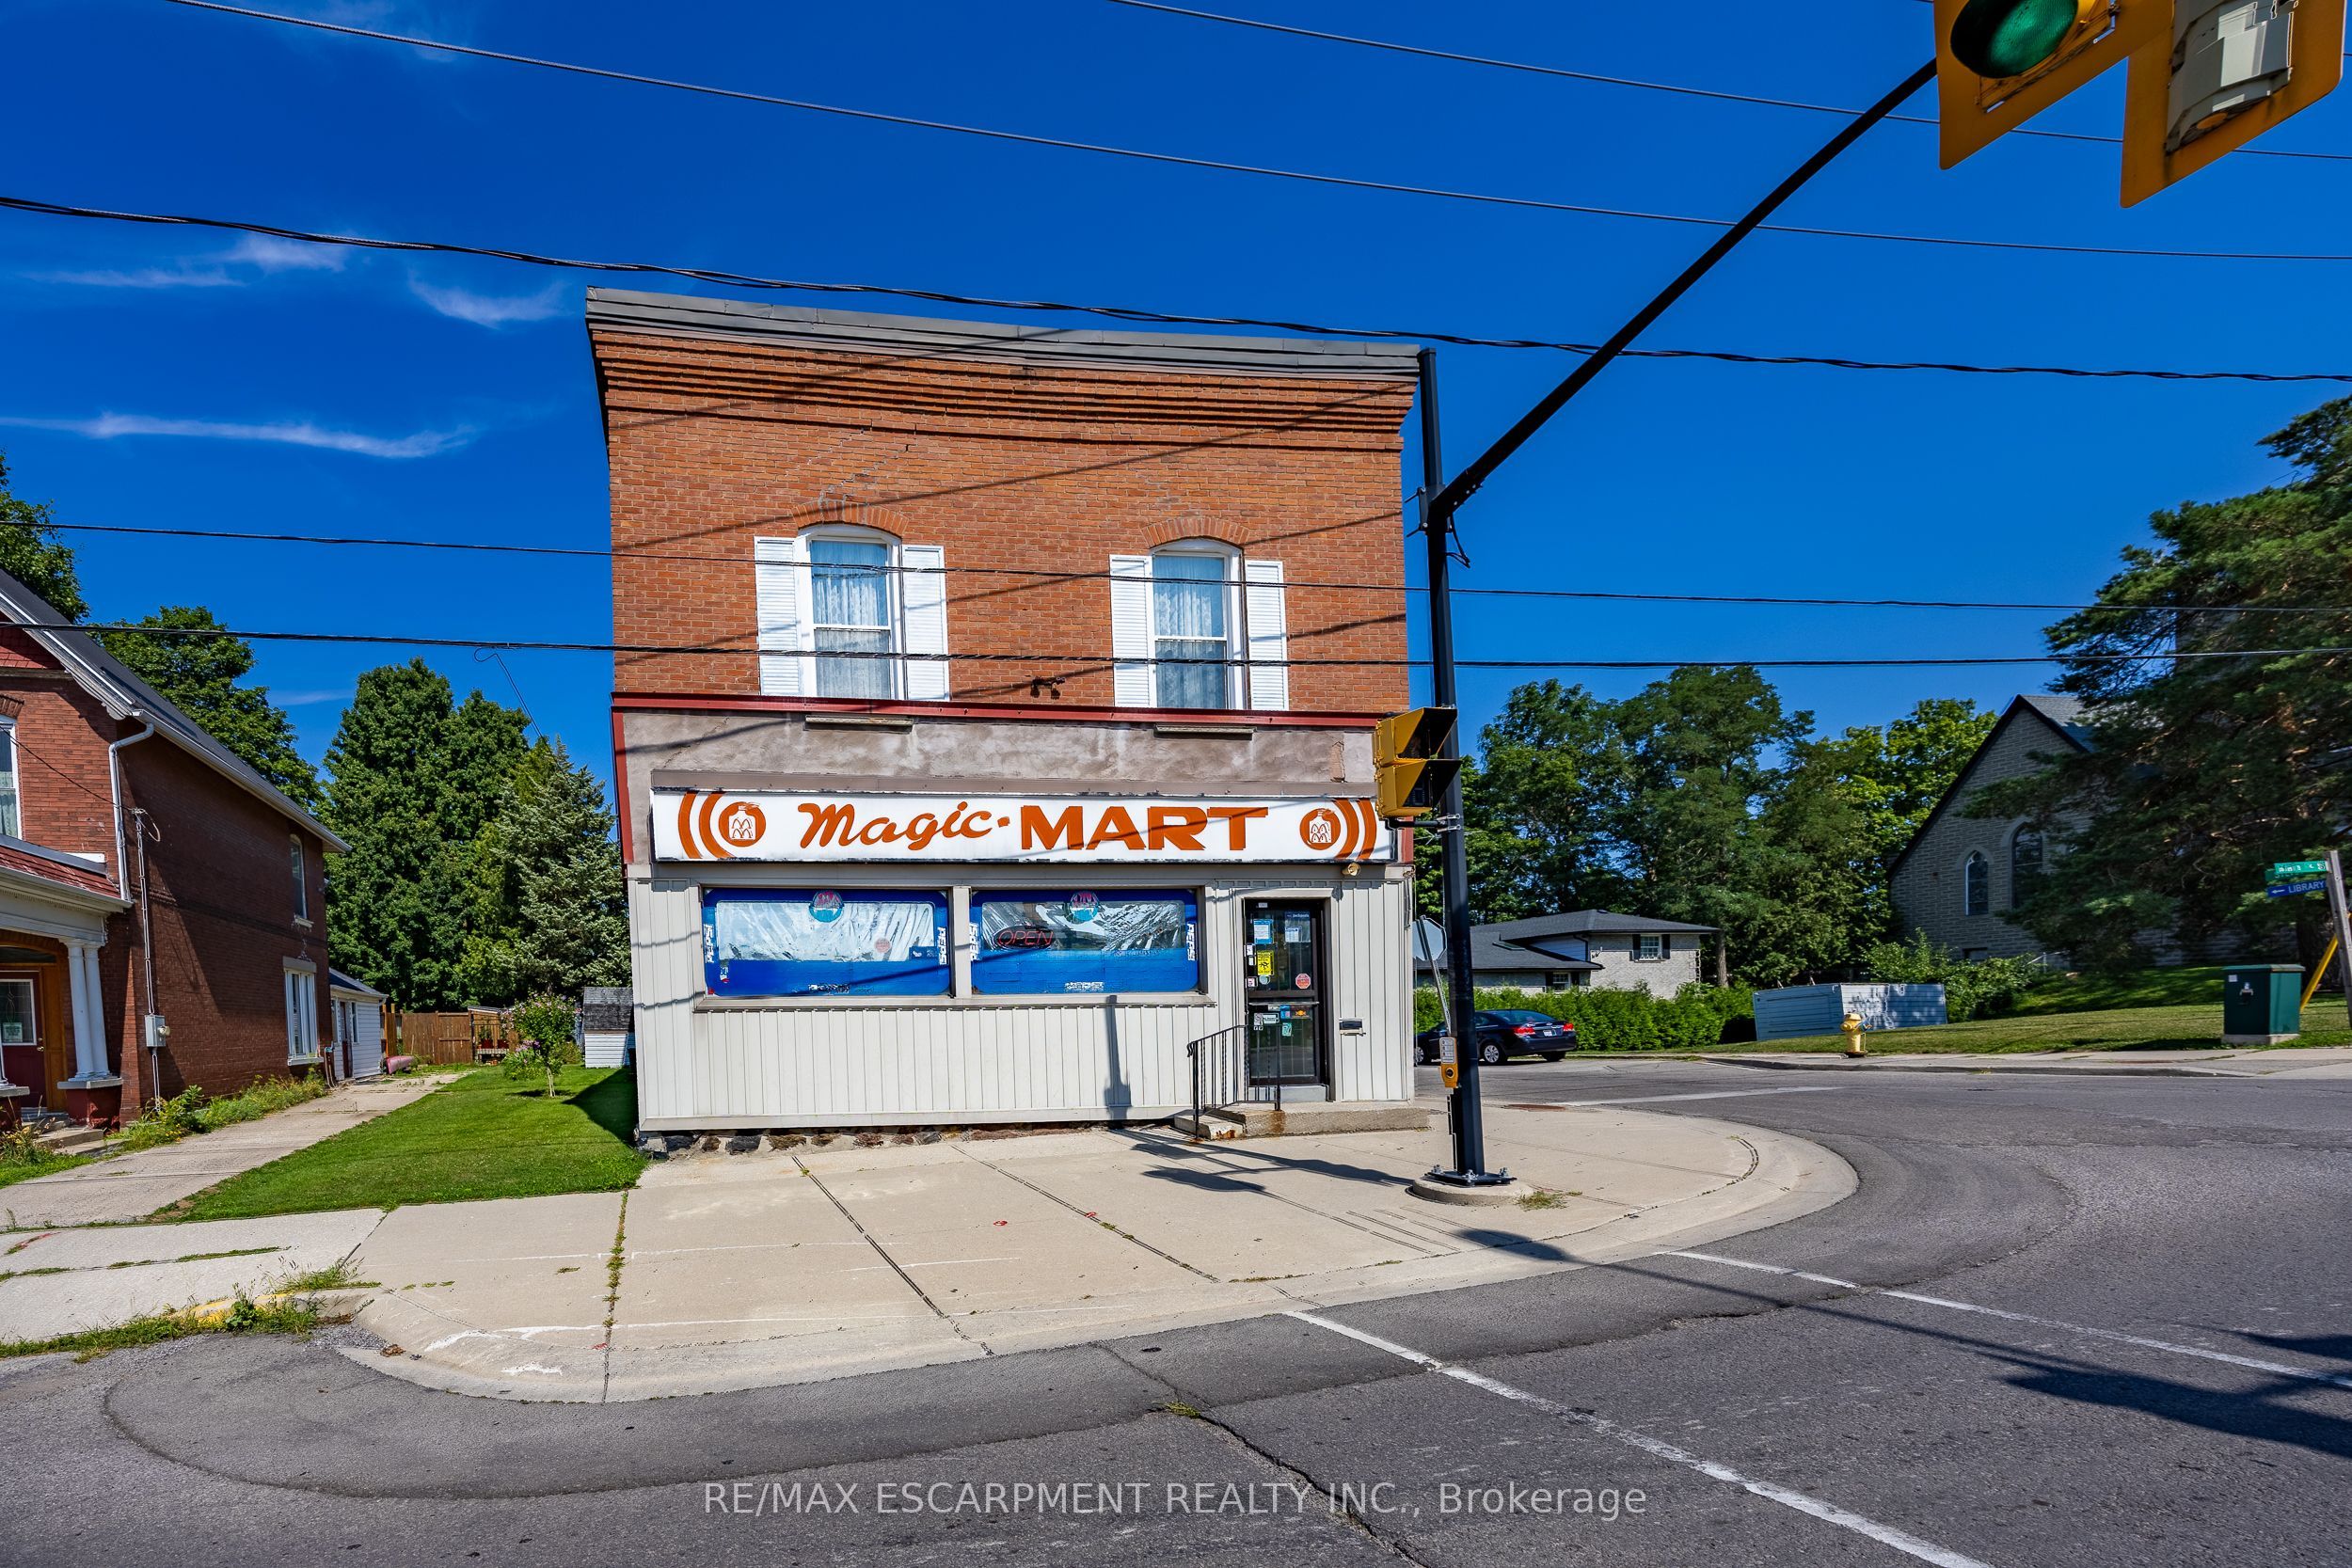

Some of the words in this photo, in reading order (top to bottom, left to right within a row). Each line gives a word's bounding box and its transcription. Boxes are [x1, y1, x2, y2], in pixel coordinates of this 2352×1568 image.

[1021, 805, 1269, 850] MART
[2288, 881, 2325, 894] LIBRARY
[703, 924, 715, 963] PEPSI
[937, 927, 947, 965] PEPSI
[968, 922, 980, 961] PEPSI
[997, 929, 1055, 945] OPEN
[1185, 923, 1197, 961] PEPSI
